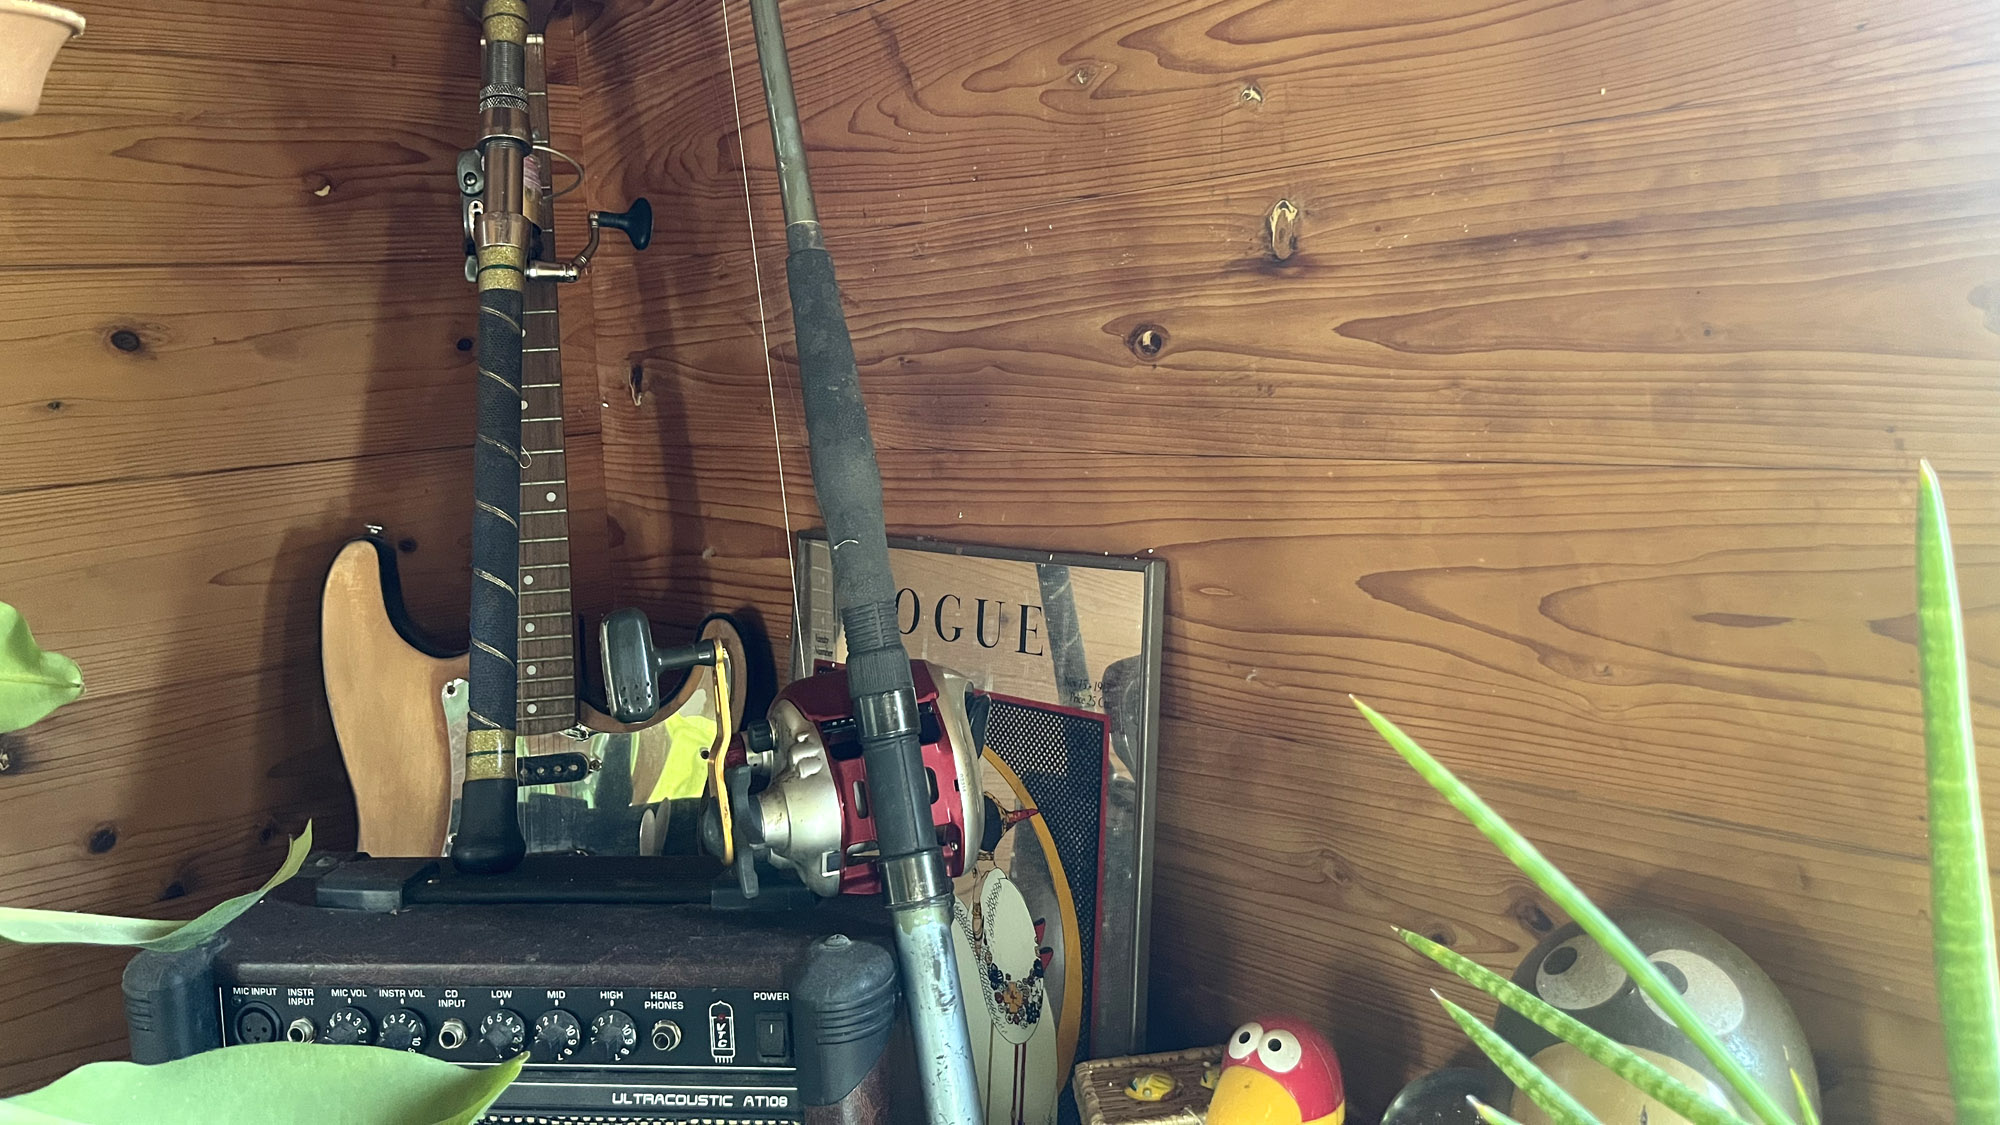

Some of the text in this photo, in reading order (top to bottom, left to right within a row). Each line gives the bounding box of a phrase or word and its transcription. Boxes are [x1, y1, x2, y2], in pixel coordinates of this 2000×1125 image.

[895, 588, 1043, 656] OGUE
[233, 987, 277, 996] MIC INPUT
[287, 988, 314, 996] INSTR
[331, 988, 367, 997] MIC VOL
[379, 989, 425, 998] INSTR VOL
[445, 990, 458, 998] CD
[491, 990, 512, 998] LOW
[547, 990, 566, 999] MID
[600, 991, 624, 999] HIGH
[650, 992, 677, 1000] HEAD
[753, 992, 790, 1001] POWER
[288, 998, 314, 1006] INPUT
[438, 1000, 466, 1008] INPUT
[644, 1001, 684, 1010] PHONES
[542, 1016, 549, 1026] 2
[553, 1014, 558, 1023] 1
[337, 1012, 342, 1022] 5
[345, 1012, 352, 1021] 4
[353, 1017, 361, 1026] 3
[358, 1027, 367, 1035] 2
[487, 1016, 493, 1024] 6
[496, 1013, 502, 1022] 5
[505, 1016, 513, 1025] 4
[512, 1026, 520, 1034] 3
[598, 1017, 605, 1026] 2
[609, 1014, 614, 1024] 1
[622, 1024, 632, 1036] 10
[389, 1014, 396, 1024] 3
[399, 1014, 406, 1023] 2
[412, 1036, 421, 1046] 10
[566, 1024, 576, 1036] 10
[716, 1023, 728, 1048] VTC
[568, 1038, 577, 1046] 9
[564, 1048, 573, 1056] 8
[612, 1092, 788, 1108] ULTRACOUSTIC AT108
